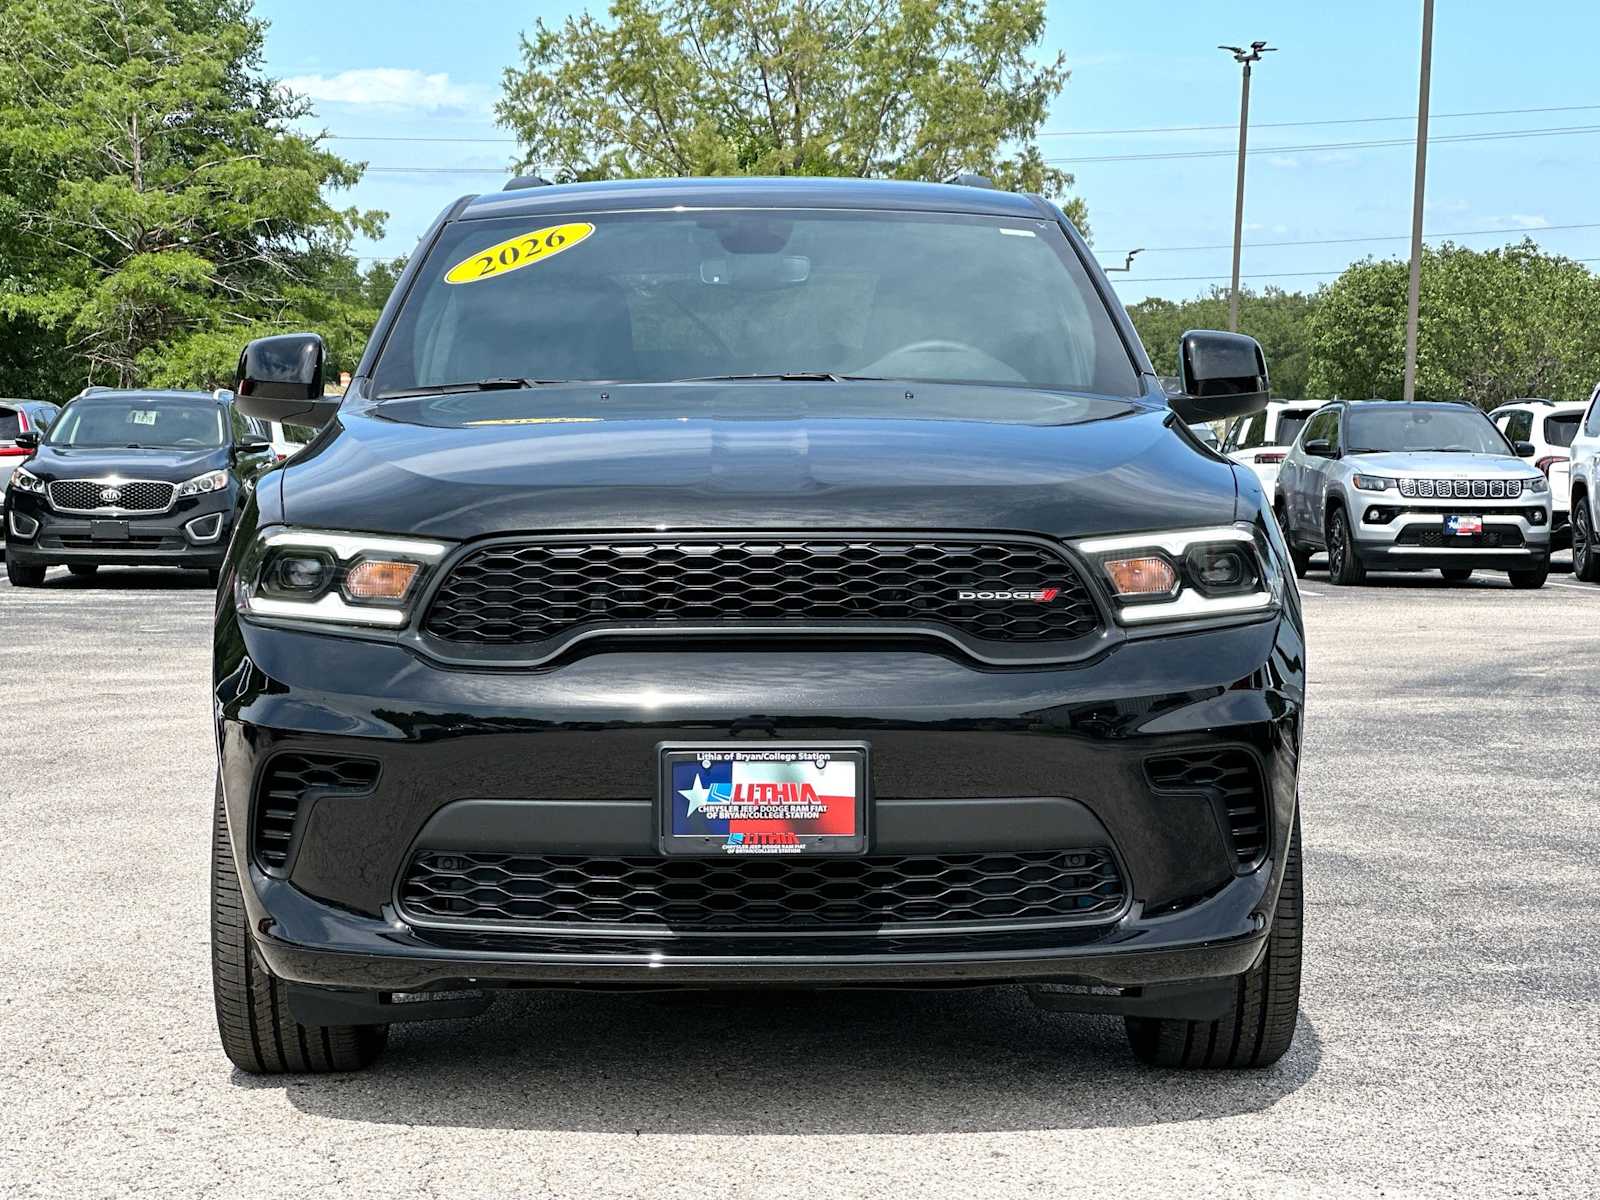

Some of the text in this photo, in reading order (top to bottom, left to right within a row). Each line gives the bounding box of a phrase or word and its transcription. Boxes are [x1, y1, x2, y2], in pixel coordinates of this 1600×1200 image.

[475, 229, 566, 276] 2026
[697, 753, 831, 763] Lithia of Bryan/College Station
[732, 783, 821, 803] LITHIA
[698, 805, 828, 813] CHRYSLER JEEP DODGE RAM FIAT
[706, 811, 820, 819] OF BRYAN/COLLEGE STATION
[743, 833, 800, 845] LITHIA
